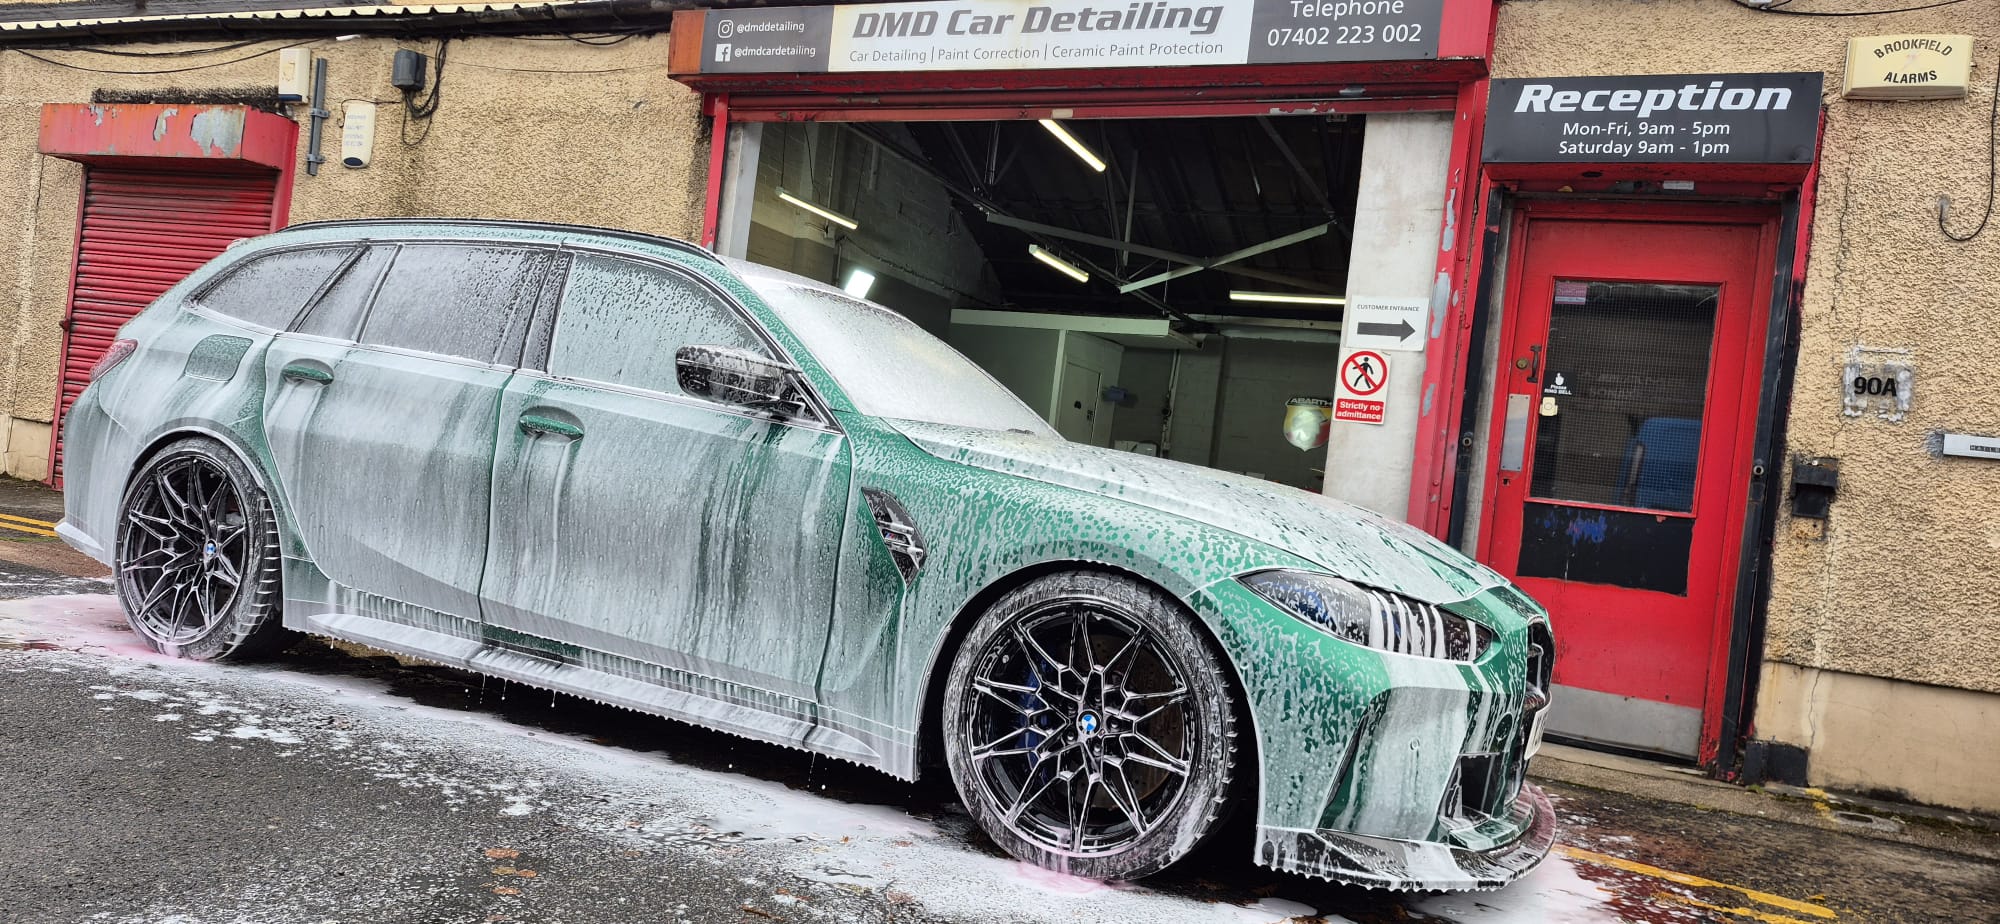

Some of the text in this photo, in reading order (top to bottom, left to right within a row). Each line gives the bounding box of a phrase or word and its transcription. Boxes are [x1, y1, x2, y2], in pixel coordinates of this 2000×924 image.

[1290, 0, 1405, 21] Telephone
[736, 21, 805, 33] @dmddetailing
[852, 2, 1225, 38] DMD Car Detailing
[1267, 23, 1422, 47] 07402 223 002
[734, 45, 816, 58] @dmdcardetailing
[849, 41, 1223, 64] Car Detailing Paint Correction Ceramic Paint Protection
[1873, 38, 1953, 59] BROOKFIELD
[1883, 70, 1938, 84] ALARMS
[1513, 81, 1793, 118] Reception
[1563, 121, 1633, 138] Mon-Fri,
[1638, 122, 1675, 136] 9am
[1692, 121, 1730, 138] 5pm
[1559, 140, 1633, 157] Saturday
[1637, 140, 1675, 154] 9am
[1692, 140, 1730, 157] 1pm
[1357, 303, 1420, 312] CUSTOMER ENTRANCE
[1853, 376, 1898, 398] 90A
[1290, 397, 1332, 406] ABARTH
[1340, 400, 1381, 411] Strictly no
[1336, 409, 1382, 420] admittance
